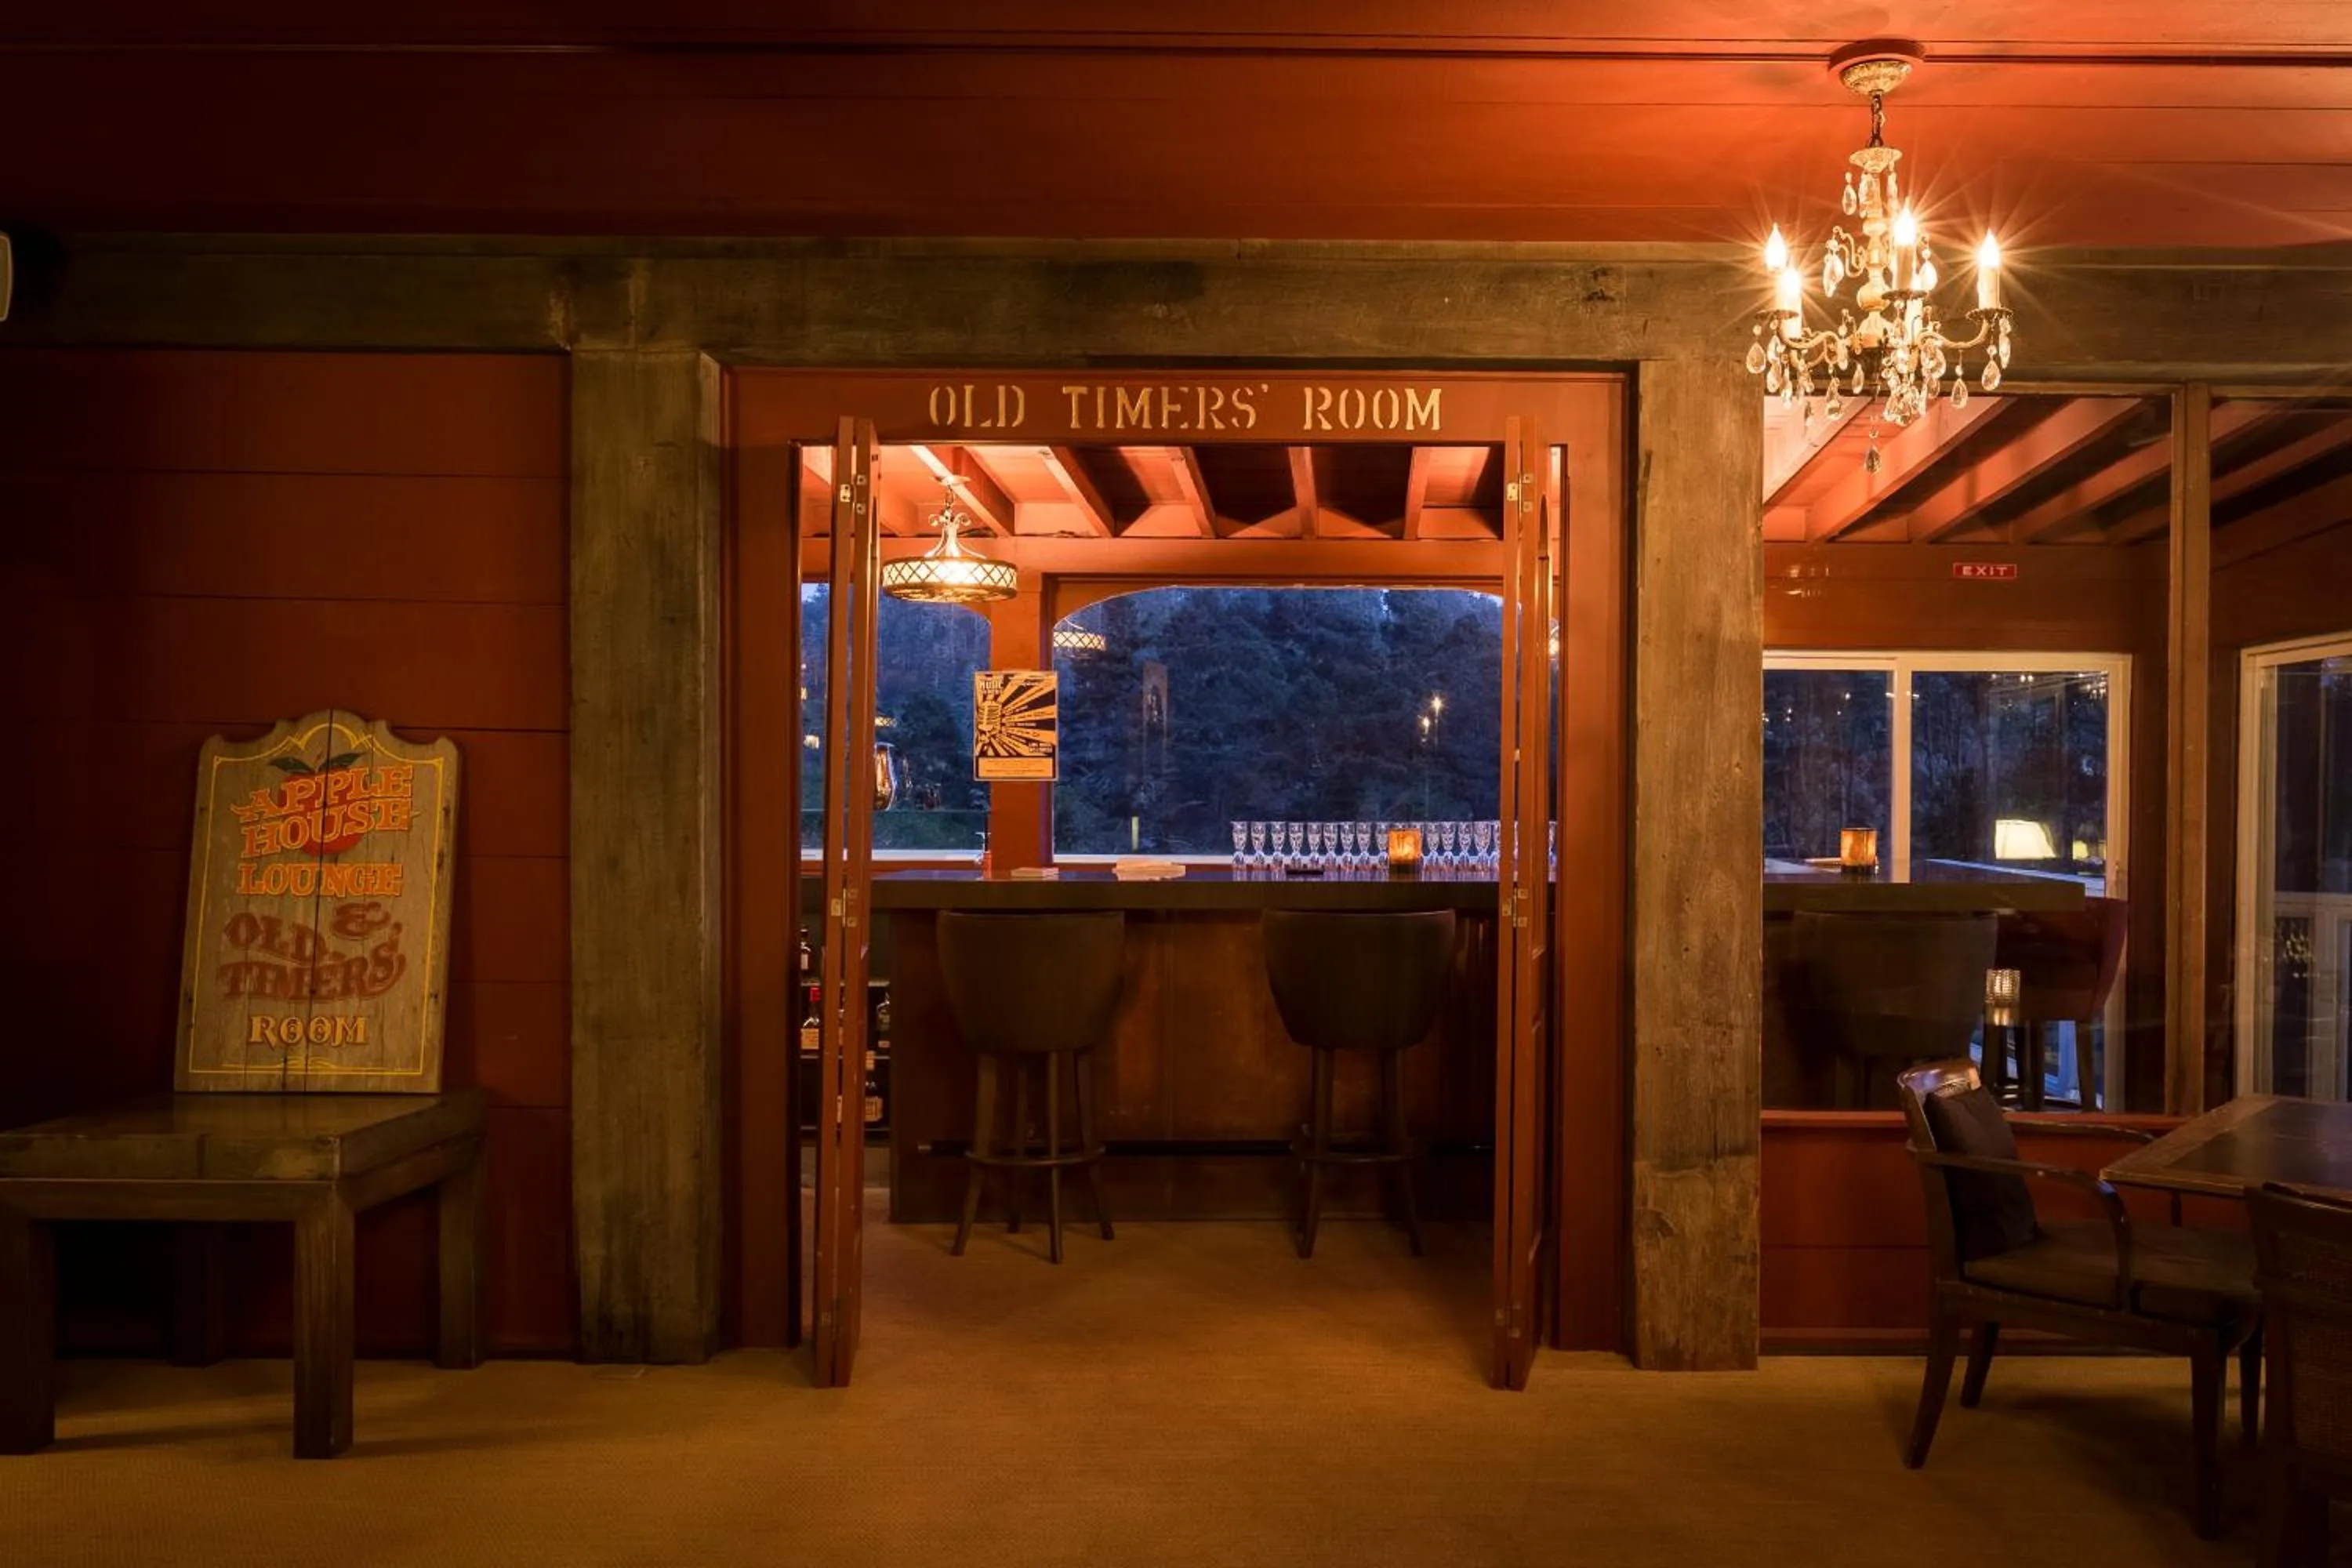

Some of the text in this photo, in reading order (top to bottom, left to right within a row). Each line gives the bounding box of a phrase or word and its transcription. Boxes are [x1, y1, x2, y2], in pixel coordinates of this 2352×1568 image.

[930, 383, 1442, 430] OLD TIMERS' ROOM
[1962, 565, 2008, 576] EXIT
[230, 764, 413, 823] APPLE
[239, 798, 414, 858] HOUSE
[236, 862, 403, 898] LOUNGE
[331, 902, 390, 940] &
[249, 1014, 368, 1051] ROOM
